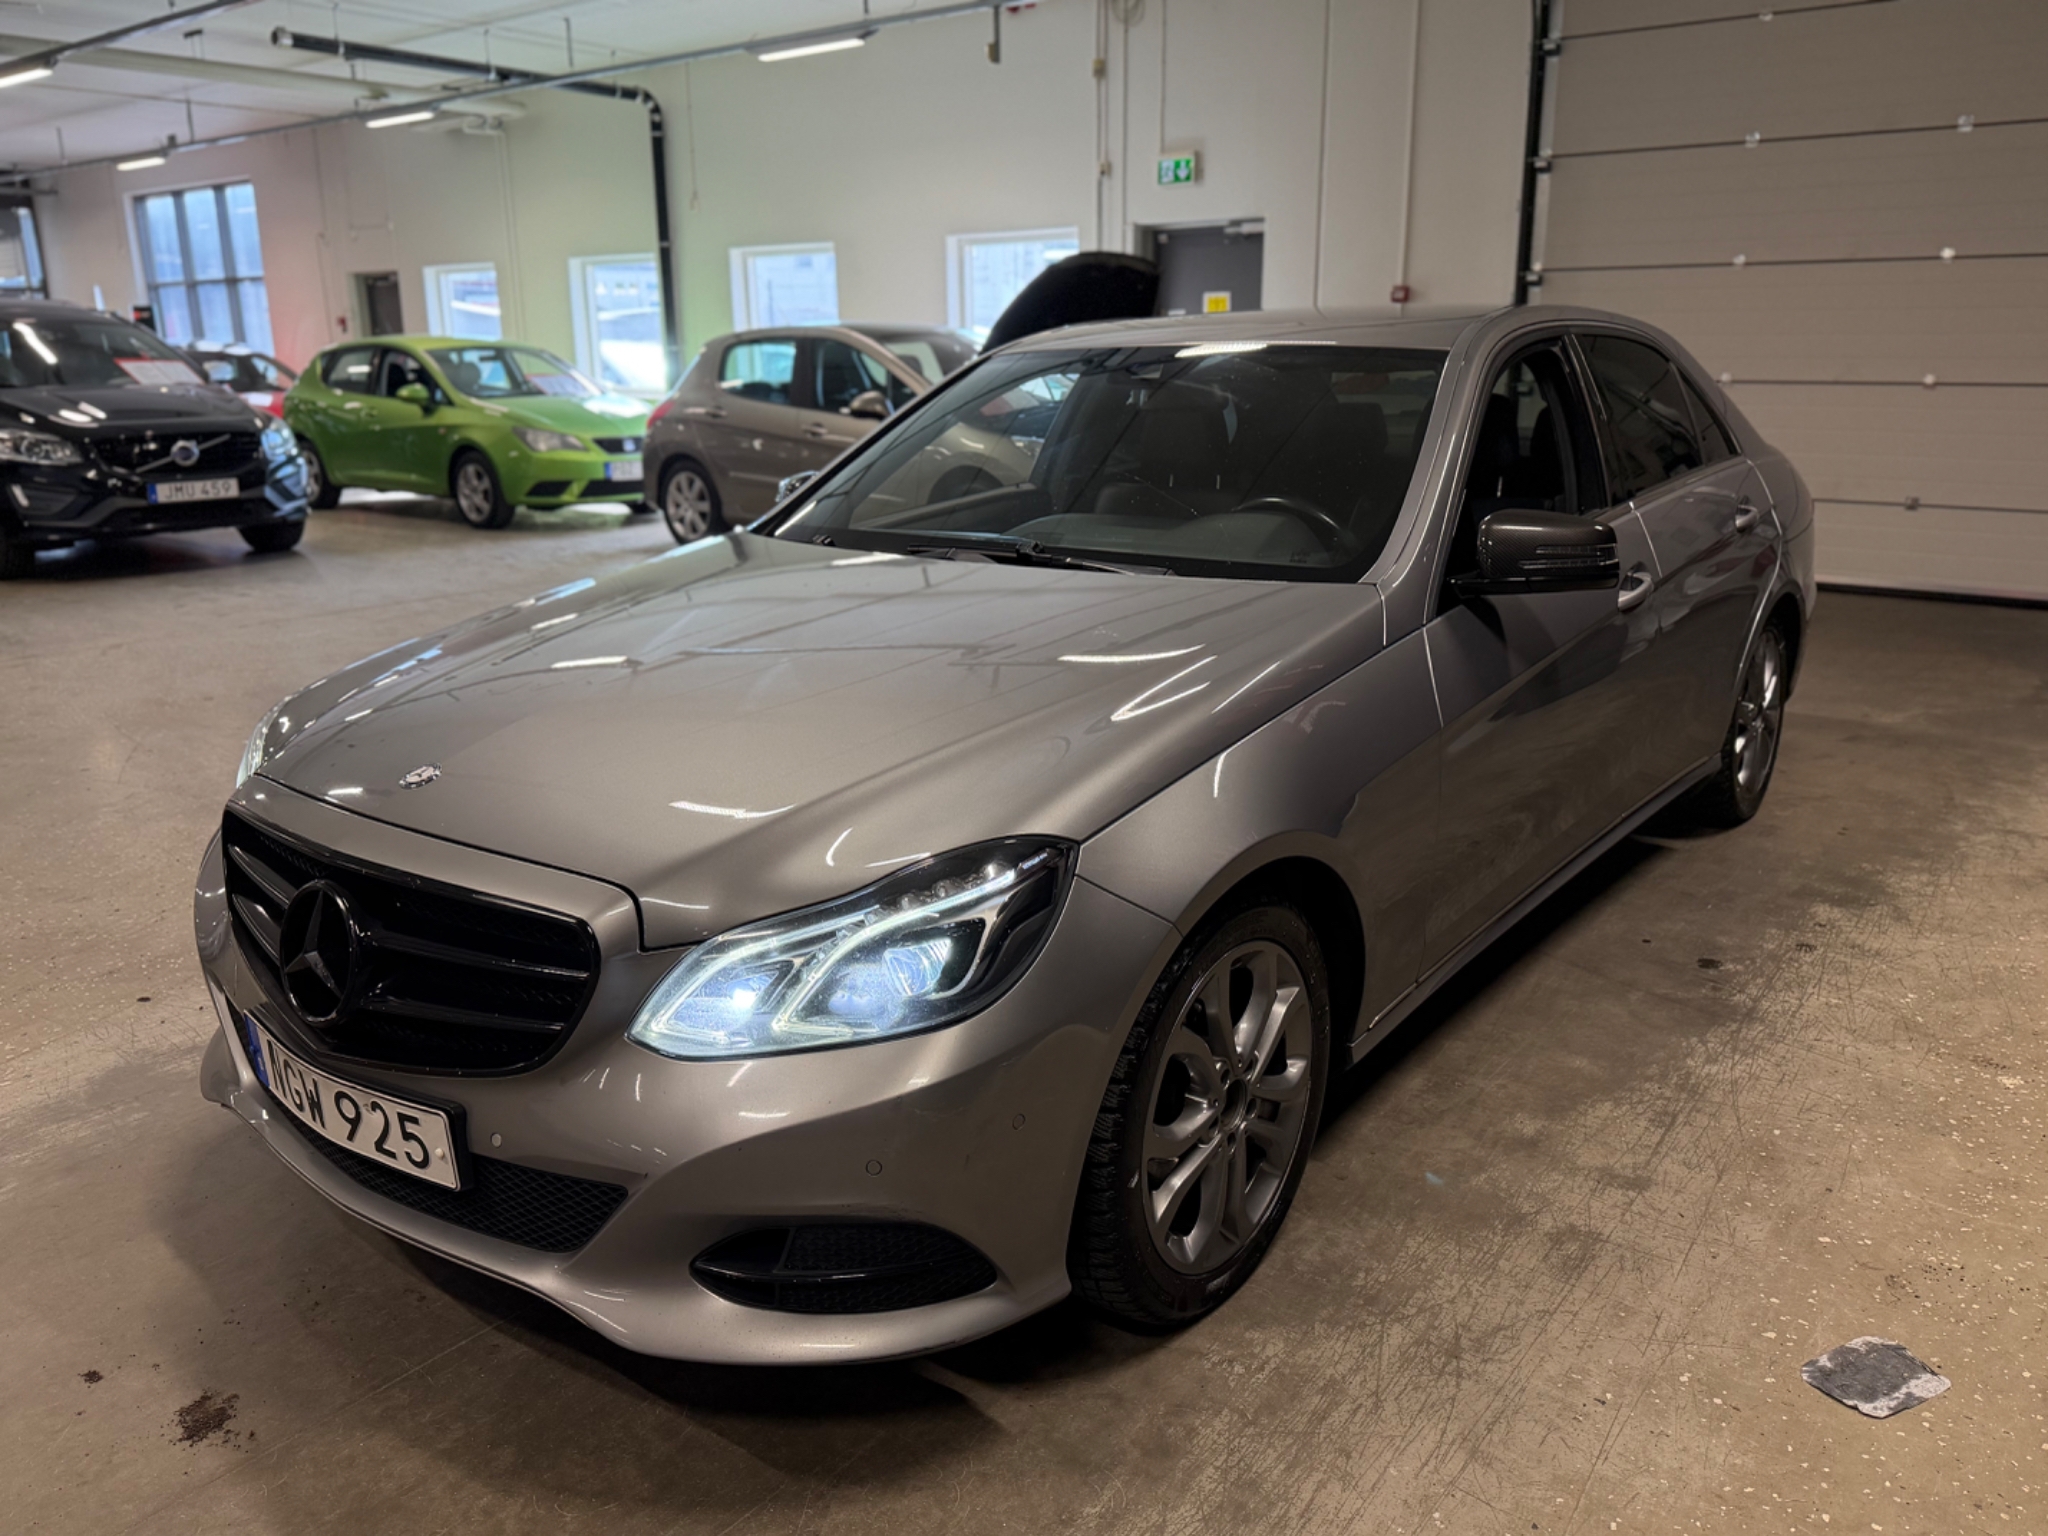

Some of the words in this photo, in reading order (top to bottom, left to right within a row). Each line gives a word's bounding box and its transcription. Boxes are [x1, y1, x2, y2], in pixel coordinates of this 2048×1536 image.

[165, 483, 196, 500] JMU
[201, 481, 232, 496] 459
[266, 1039, 327, 1130] NGW
[333, 1090, 430, 1169] 925
